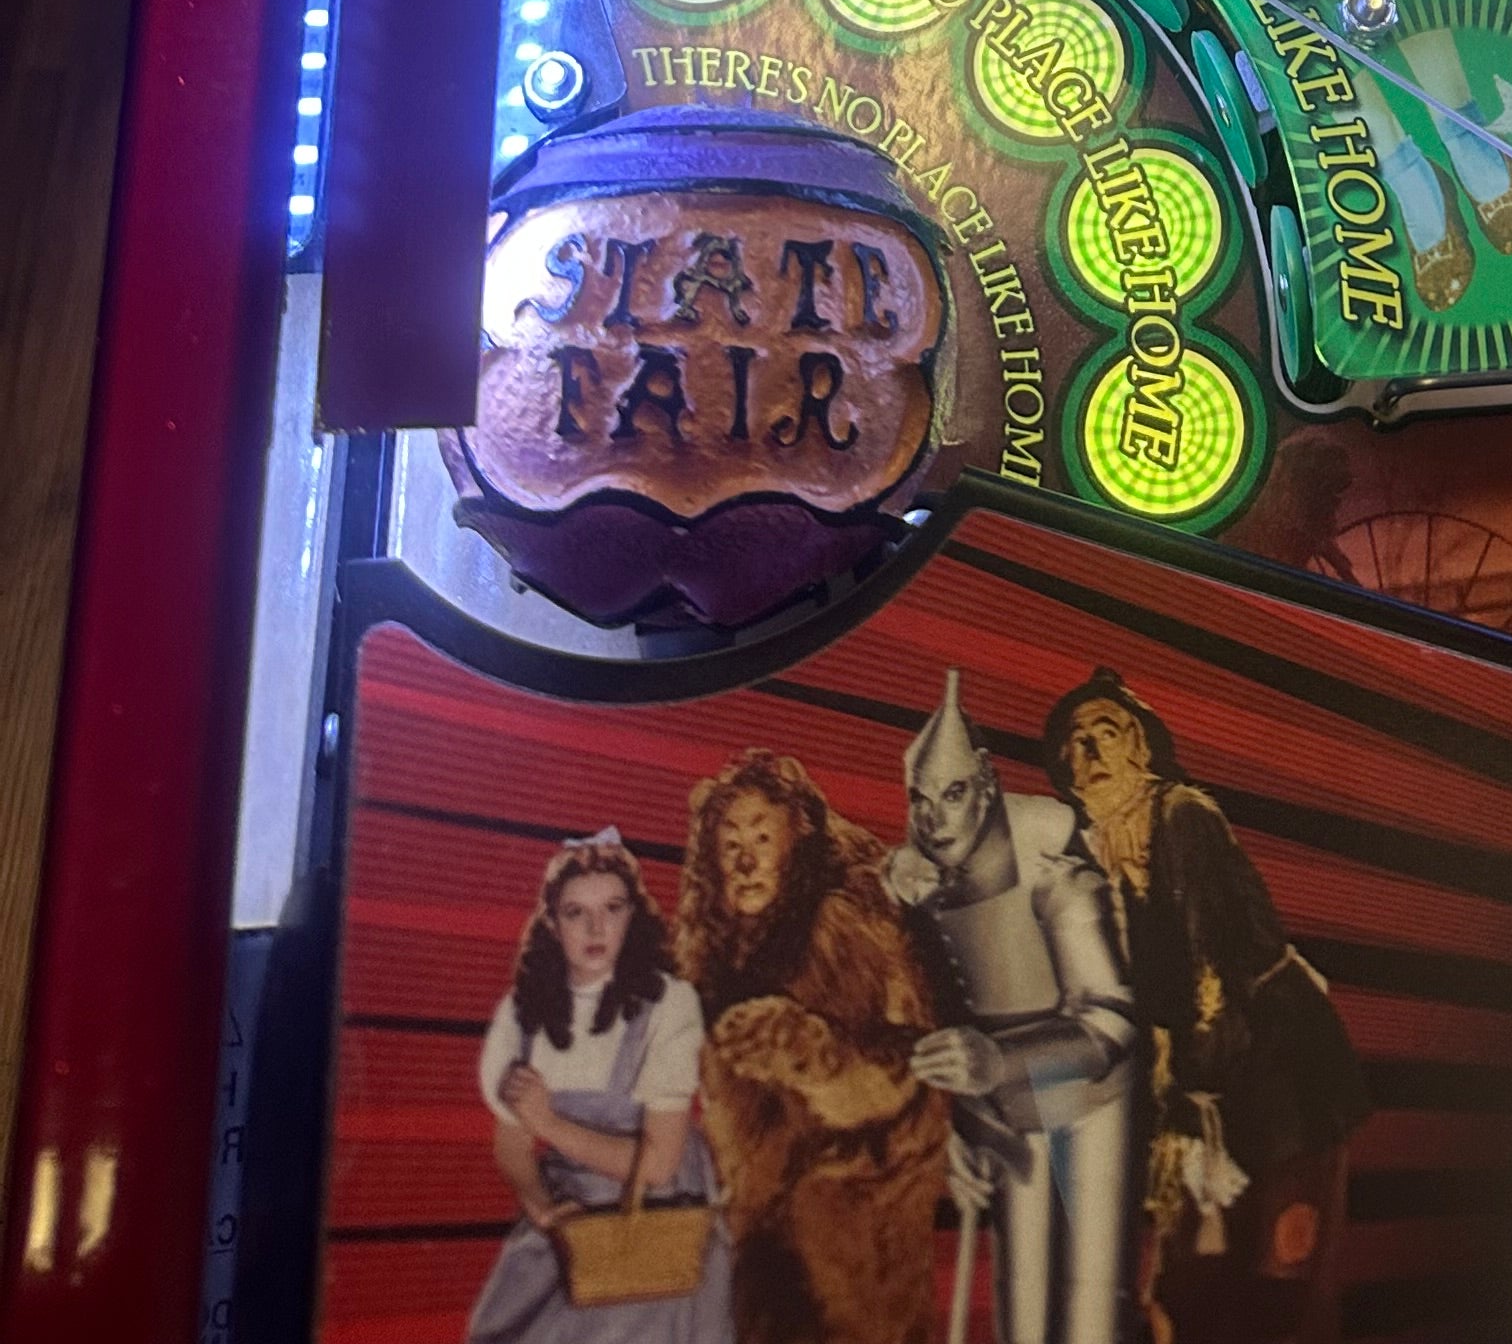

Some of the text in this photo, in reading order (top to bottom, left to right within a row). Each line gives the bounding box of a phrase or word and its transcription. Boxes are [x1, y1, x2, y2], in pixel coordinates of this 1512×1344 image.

[631, 46, 813, 104] THERE'S
[812, 76, 883, 136] NO
[877, 117, 994, 245] PLACE
[967, 238, 1036, 339] LIKE
[1081, 137, 1169, 265] LIKE
[1309, 117, 1405, 331] HOME
[513, 230, 898, 334] STATE
[550, 343, 860, 451] FAIR
[1119, 266, 1186, 472] HOME
